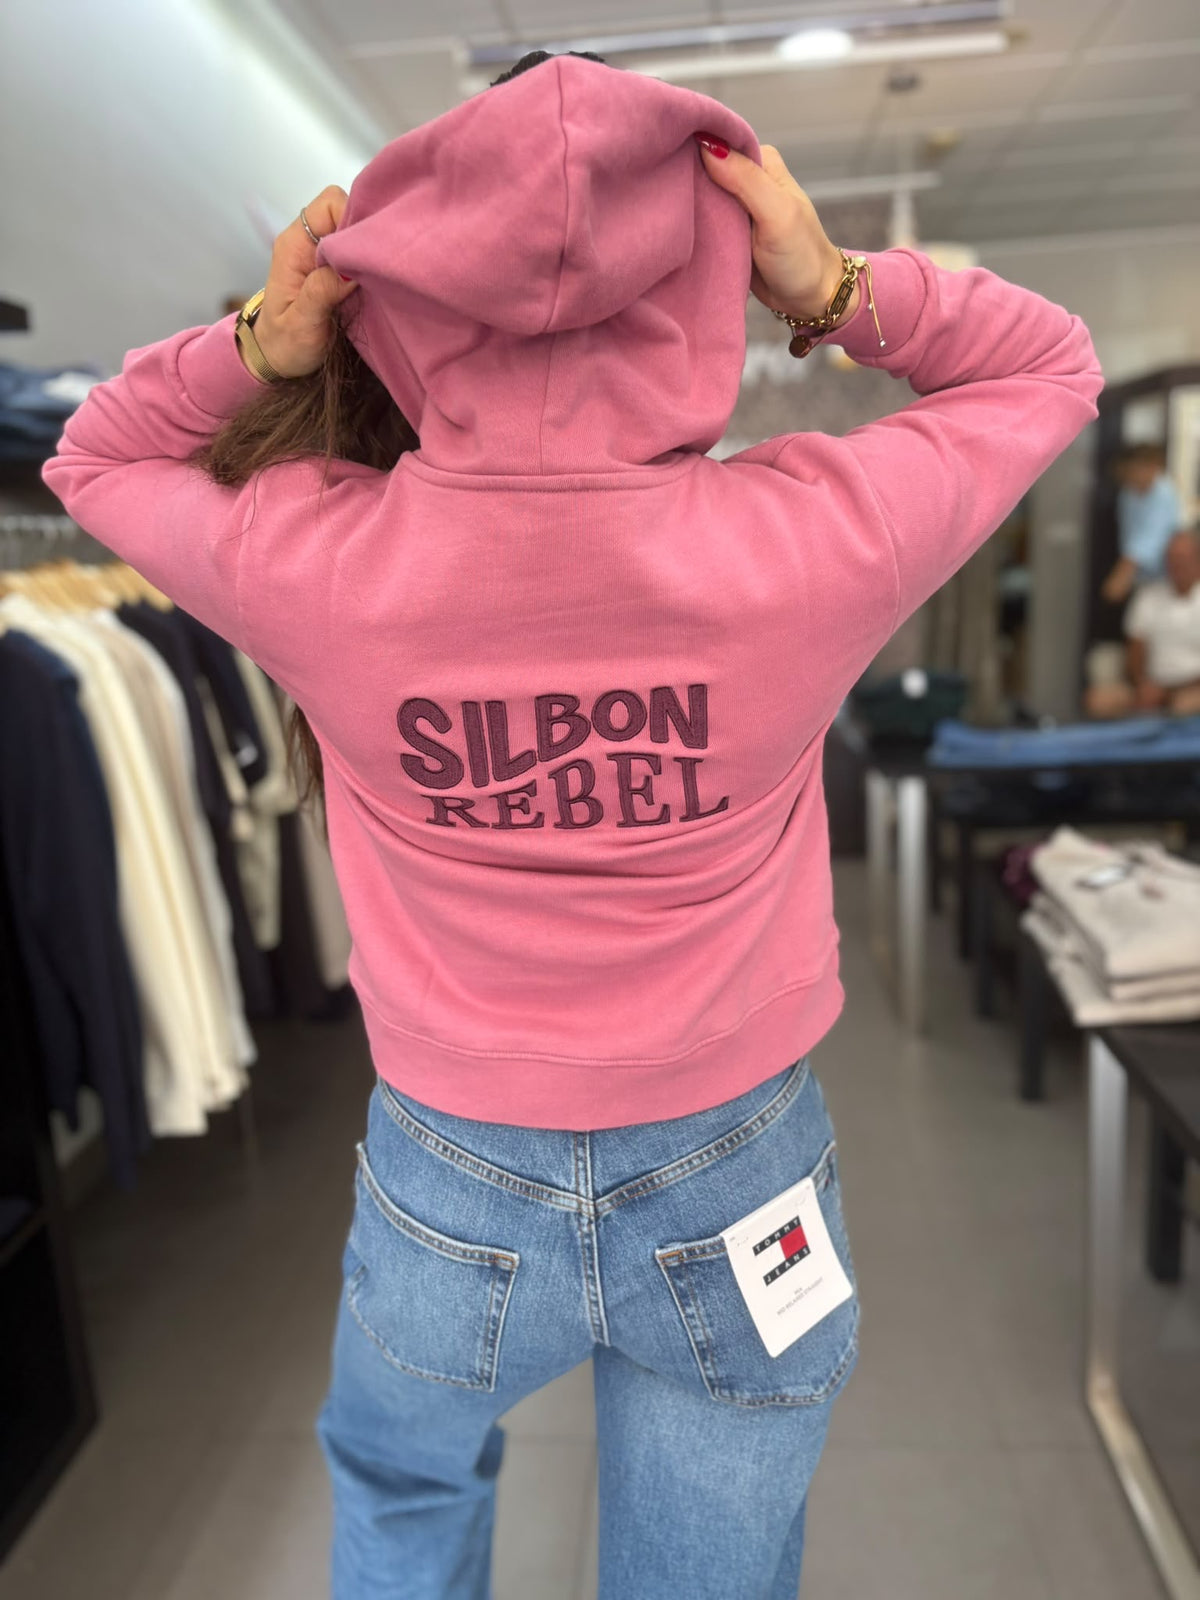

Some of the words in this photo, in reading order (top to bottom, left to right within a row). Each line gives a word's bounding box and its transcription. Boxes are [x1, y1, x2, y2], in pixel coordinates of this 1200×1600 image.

[397, 683, 708, 789] SILBON
[420, 752, 730, 830] REBEL
[755, 1218, 801, 1253] TOMMY
[766, 1248, 809, 1283] JEANS
